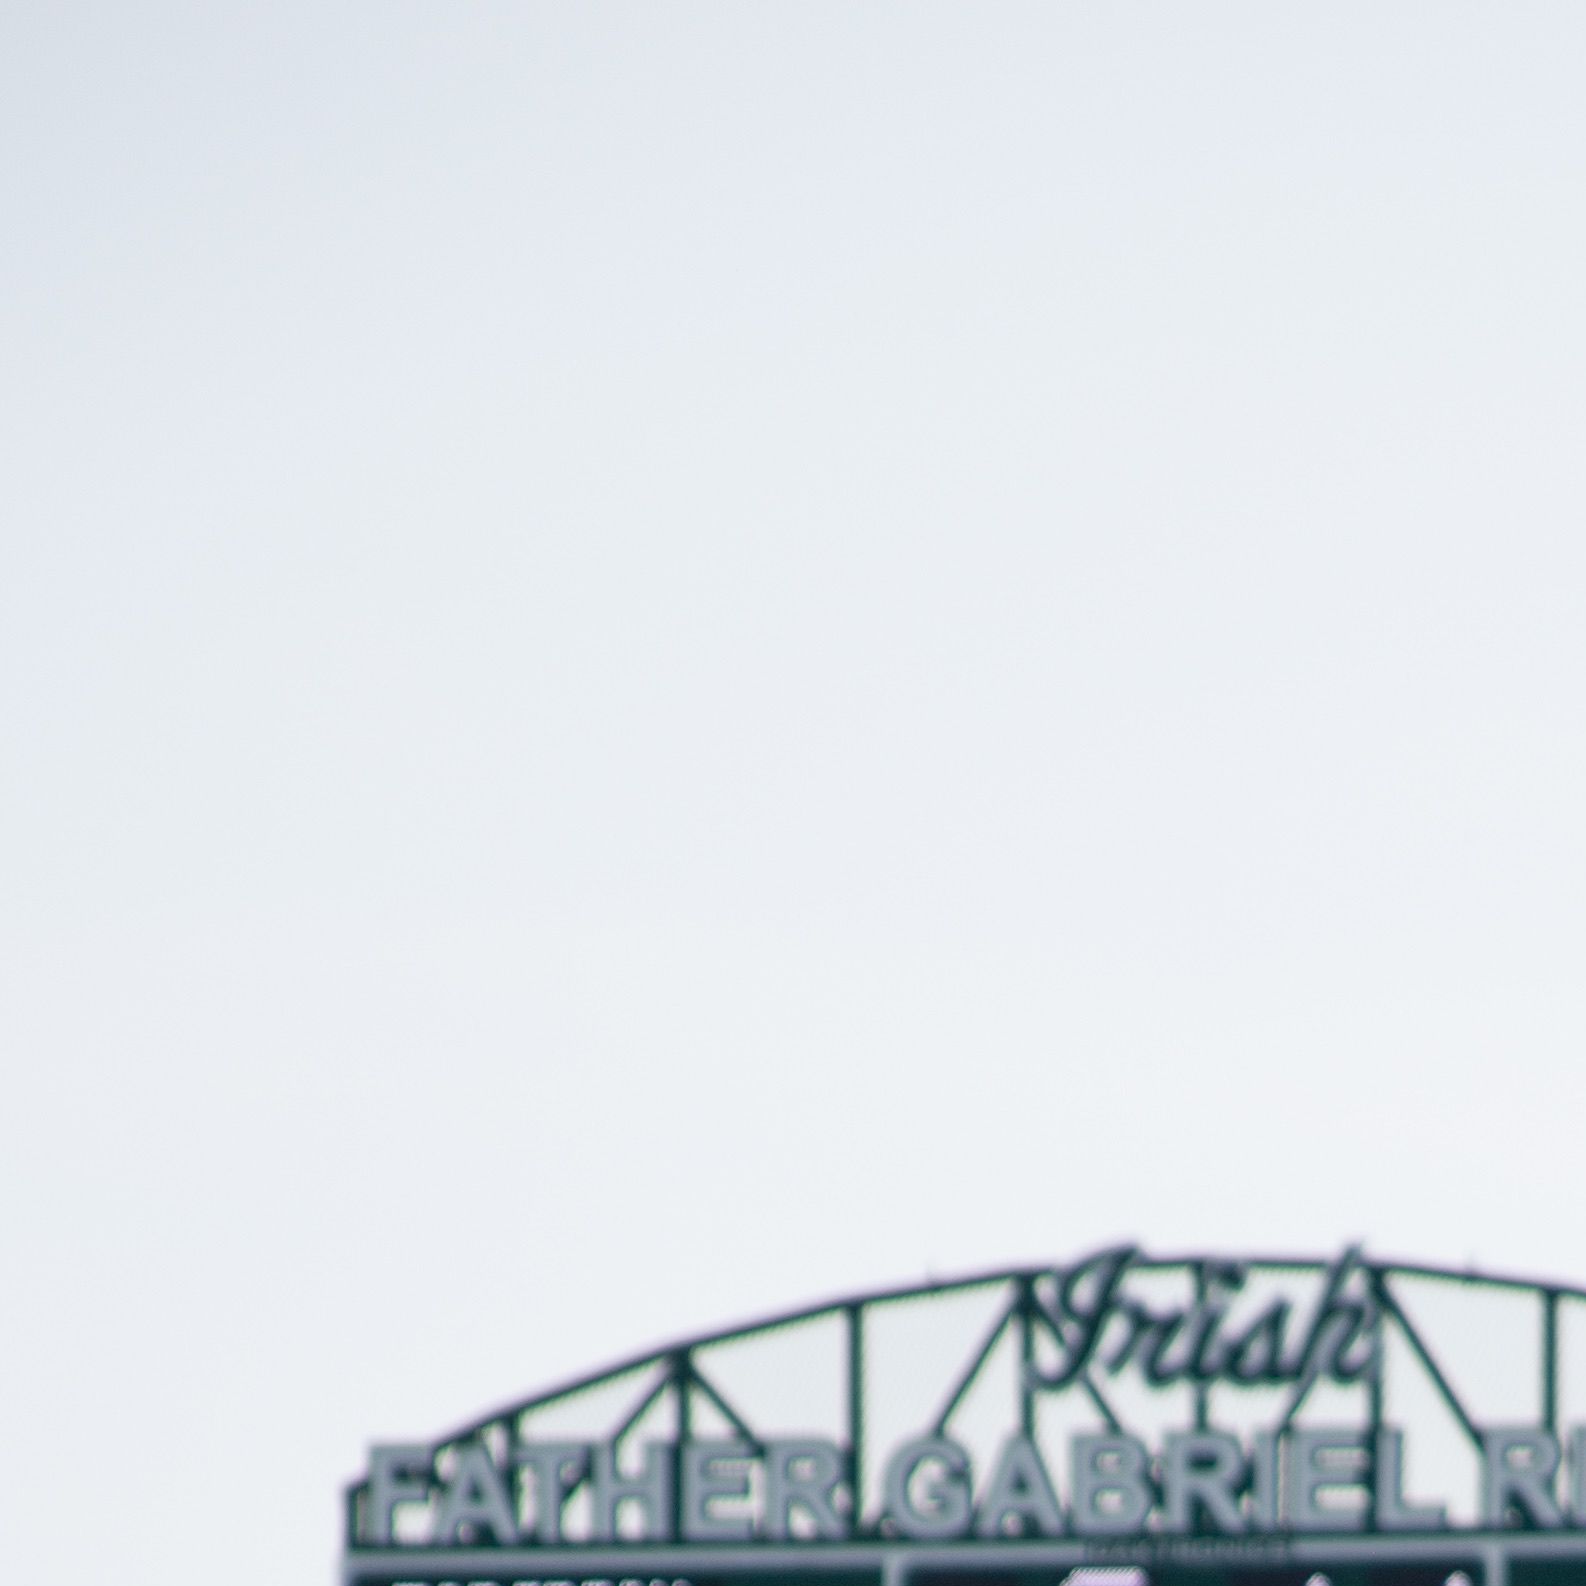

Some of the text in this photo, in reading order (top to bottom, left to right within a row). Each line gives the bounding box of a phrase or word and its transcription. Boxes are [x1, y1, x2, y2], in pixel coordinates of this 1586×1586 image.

[1028, 1240, 1378, 1392] Irish
[366, 1437, 849, 1542] FATHER
[883, 1424, 1447, 1541] GABRIEL
